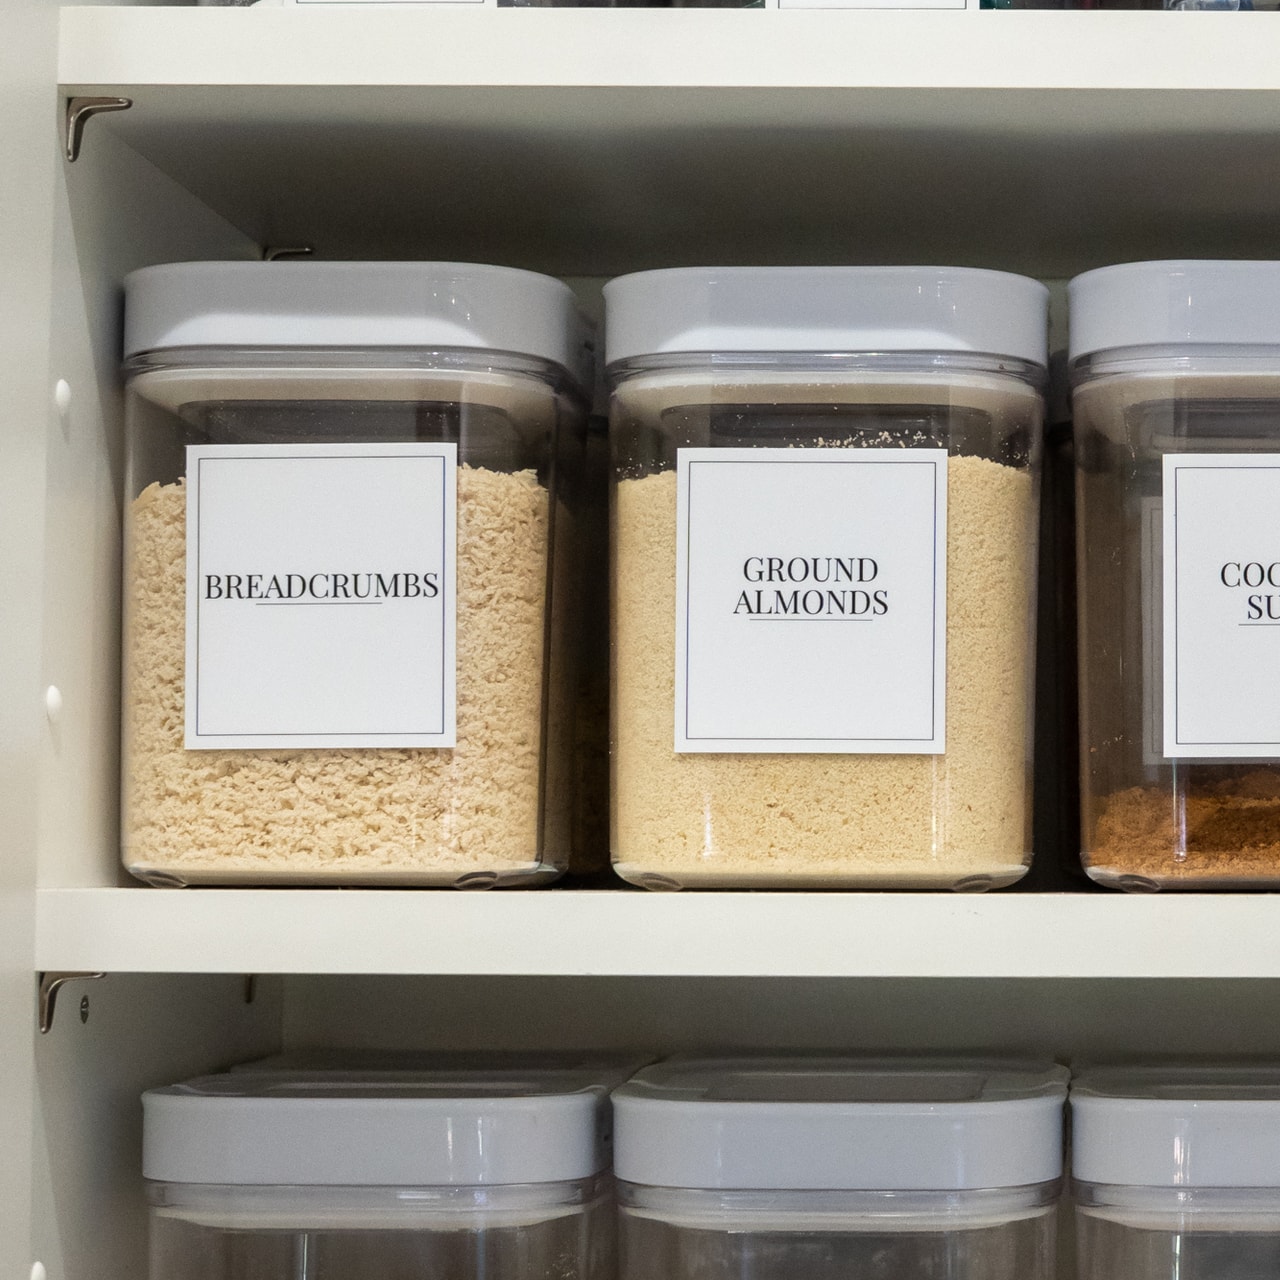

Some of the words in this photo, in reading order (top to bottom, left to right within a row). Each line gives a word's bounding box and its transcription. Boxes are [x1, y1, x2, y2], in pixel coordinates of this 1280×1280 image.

[743, 556, 879, 583] GROUND
[205, 572, 439, 600] BREADCRUMBS
[732, 589, 889, 616] ALMONDS
